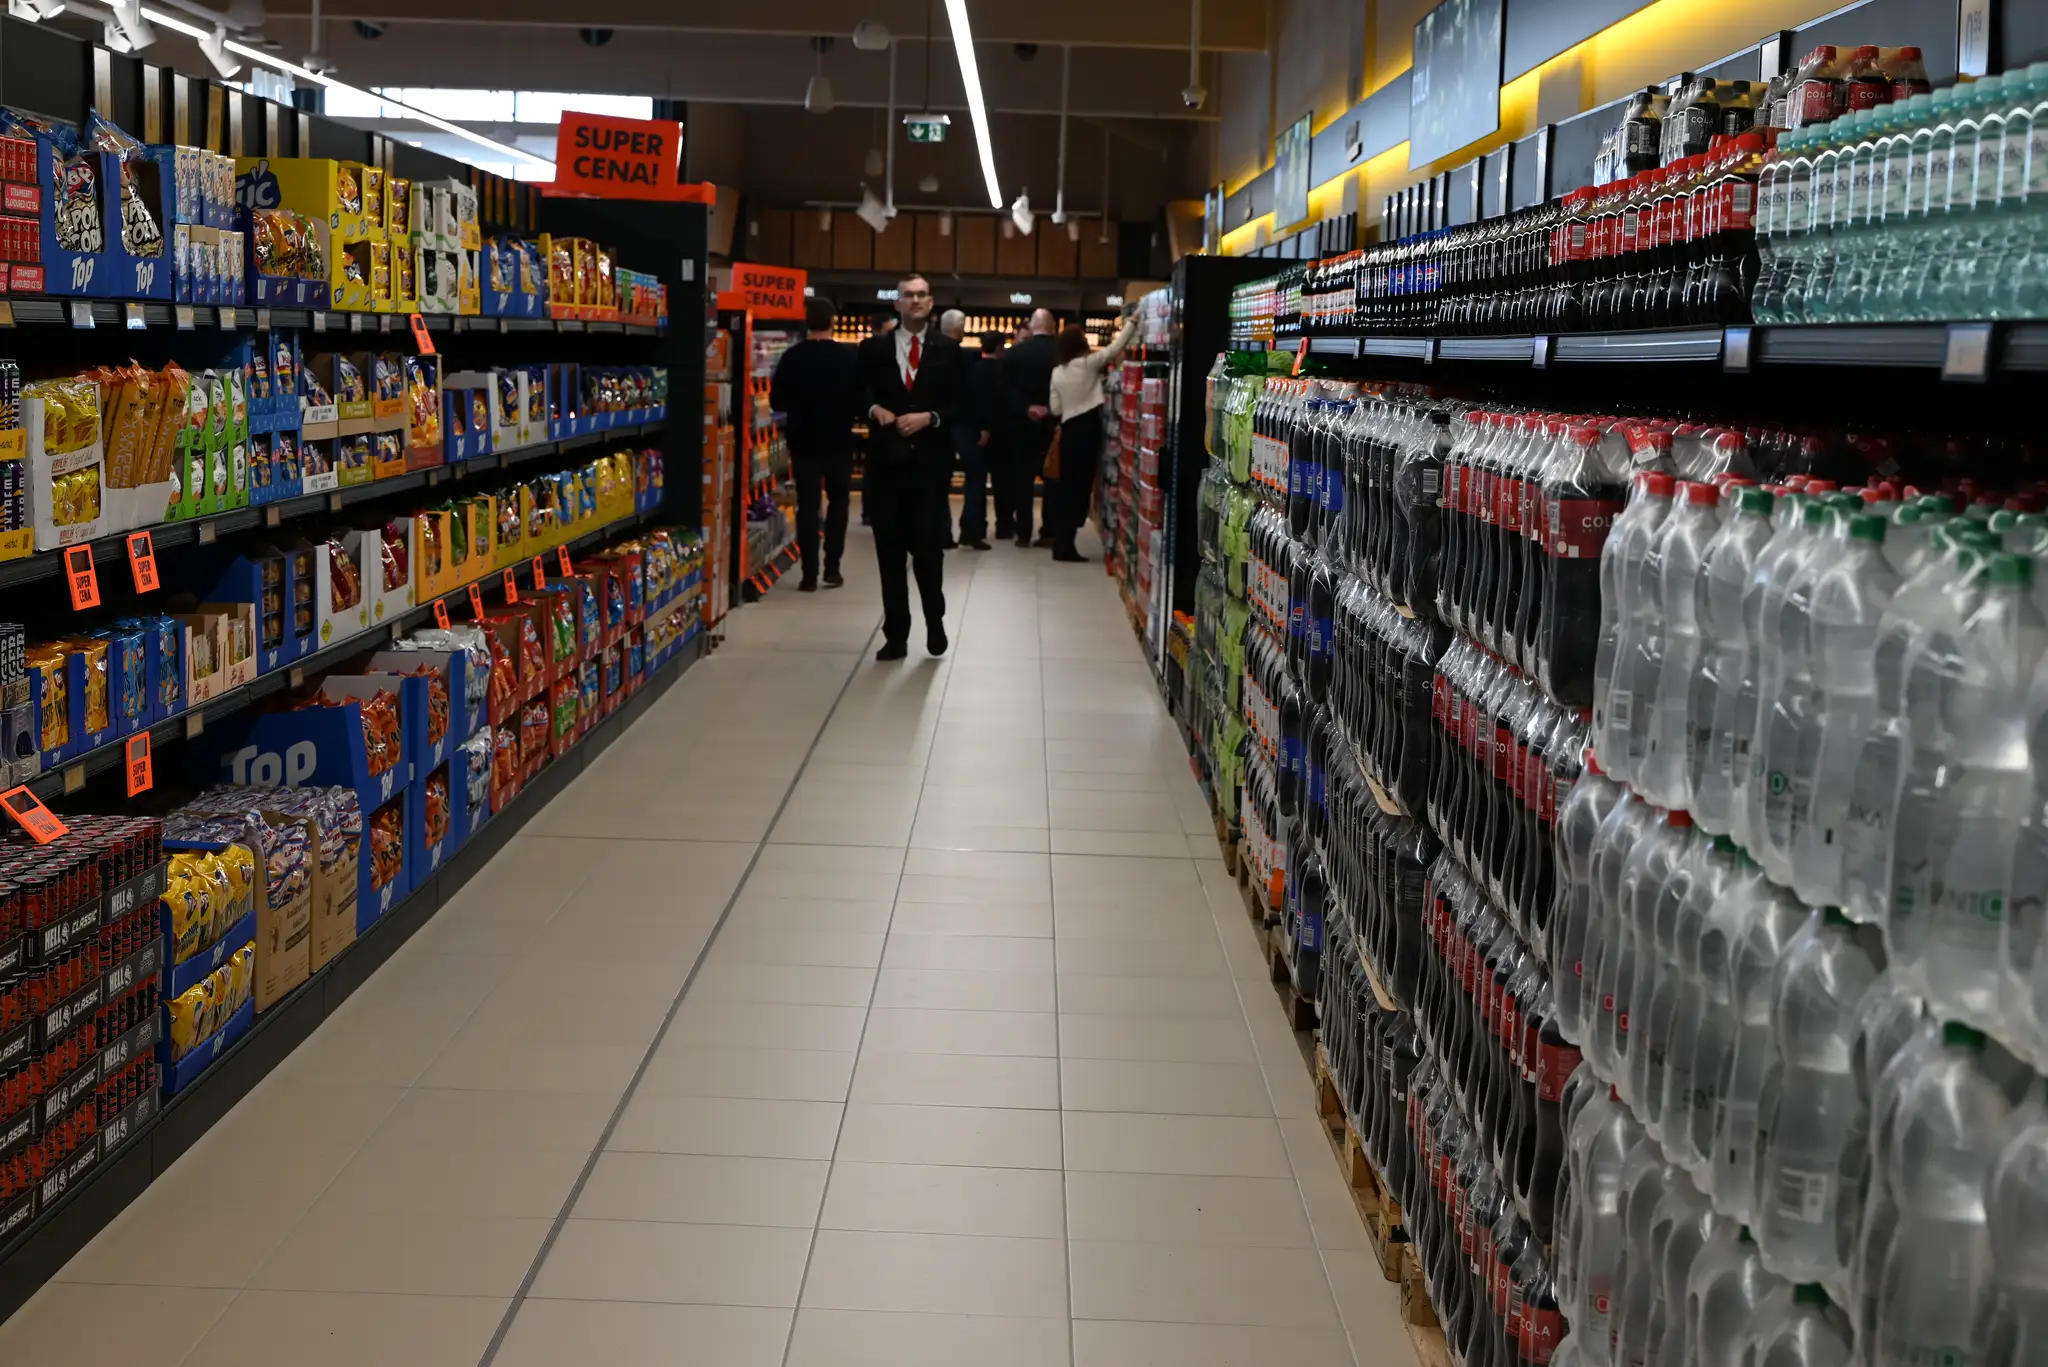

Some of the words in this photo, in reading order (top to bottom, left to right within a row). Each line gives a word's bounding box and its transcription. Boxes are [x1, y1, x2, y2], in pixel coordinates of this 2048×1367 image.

[1807, 91, 1832, 99] COLA
[1860, 91, 1884, 100] COLA
[1691, 116, 1714, 125] COLA
[575, 125, 664, 156] SUPER
[573, 155, 659, 186] CENA!
[743, 272, 796, 290] SUPER
[76, 575, 91, 590] SUPER
[79, 589, 92, 602] CENA
[132, 761, 146, 776] SUPER
[134, 775, 146, 788] CENA
[112, 891, 126, 914] HELL
[45, 924, 62, 952] HELL
[72, 909, 98, 934] CLASSIC
[110, 967, 124, 993] HELL
[47, 1010, 62, 1036] HELL
[73, 988, 98, 1016] CLASSIC
[104, 1044, 121, 1070] HELL
[46, 1093, 62, 1120] HELL
[71, 1067, 96, 1099] CLASSIC
[106, 1126, 120, 1148] HELL
[43, 1176, 58, 1202] HELL
[69, 1146, 96, 1179] CLASSIC
[1520, 1317, 1551, 1336] COLA
